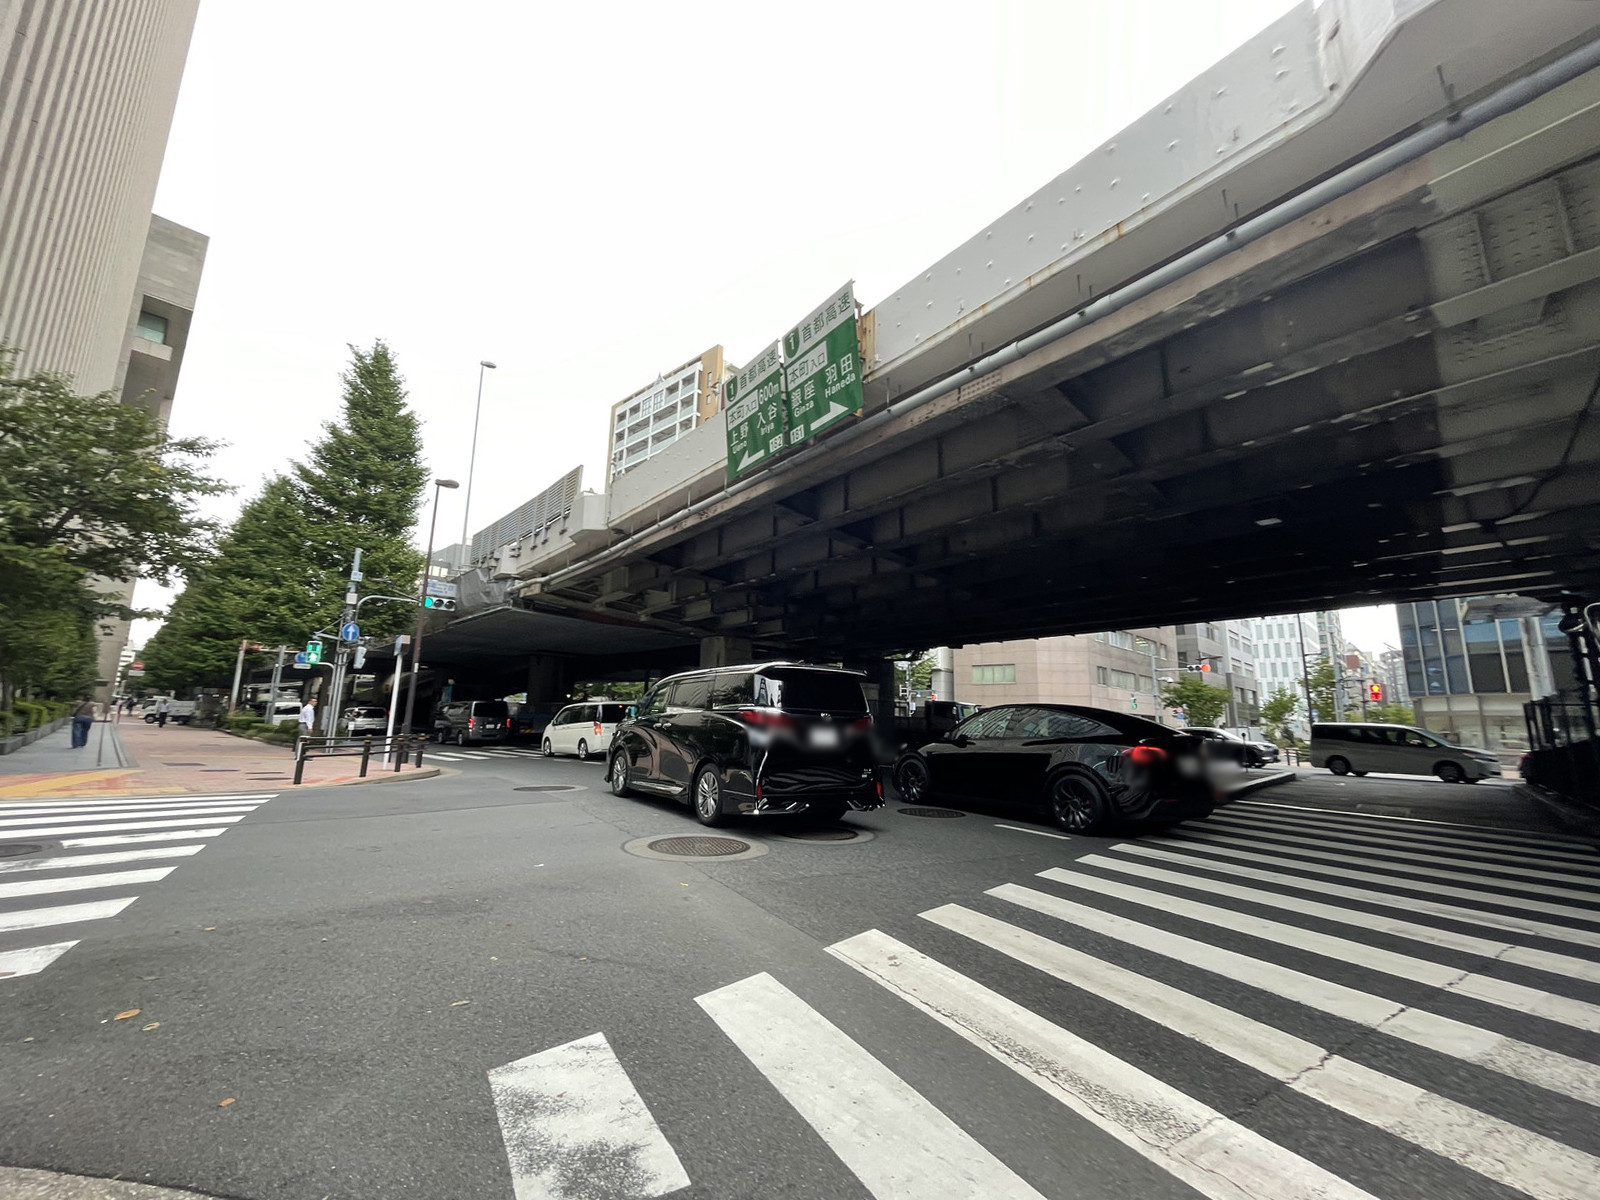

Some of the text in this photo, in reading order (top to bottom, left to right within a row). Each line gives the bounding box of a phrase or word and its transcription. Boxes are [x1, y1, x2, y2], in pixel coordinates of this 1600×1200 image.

[802, 291, 850, 343] 首都高速
[740, 349, 777, 389] 首都高速
[789, 352, 825, 384] 本町入口
[791, 353, 853, 409] 銀座 羽田
[728, 381, 779, 424] 本町入口 600m
[793, 372, 856, 417] Ginza Haneda
[730, 402, 777, 446] 上野 入谷
